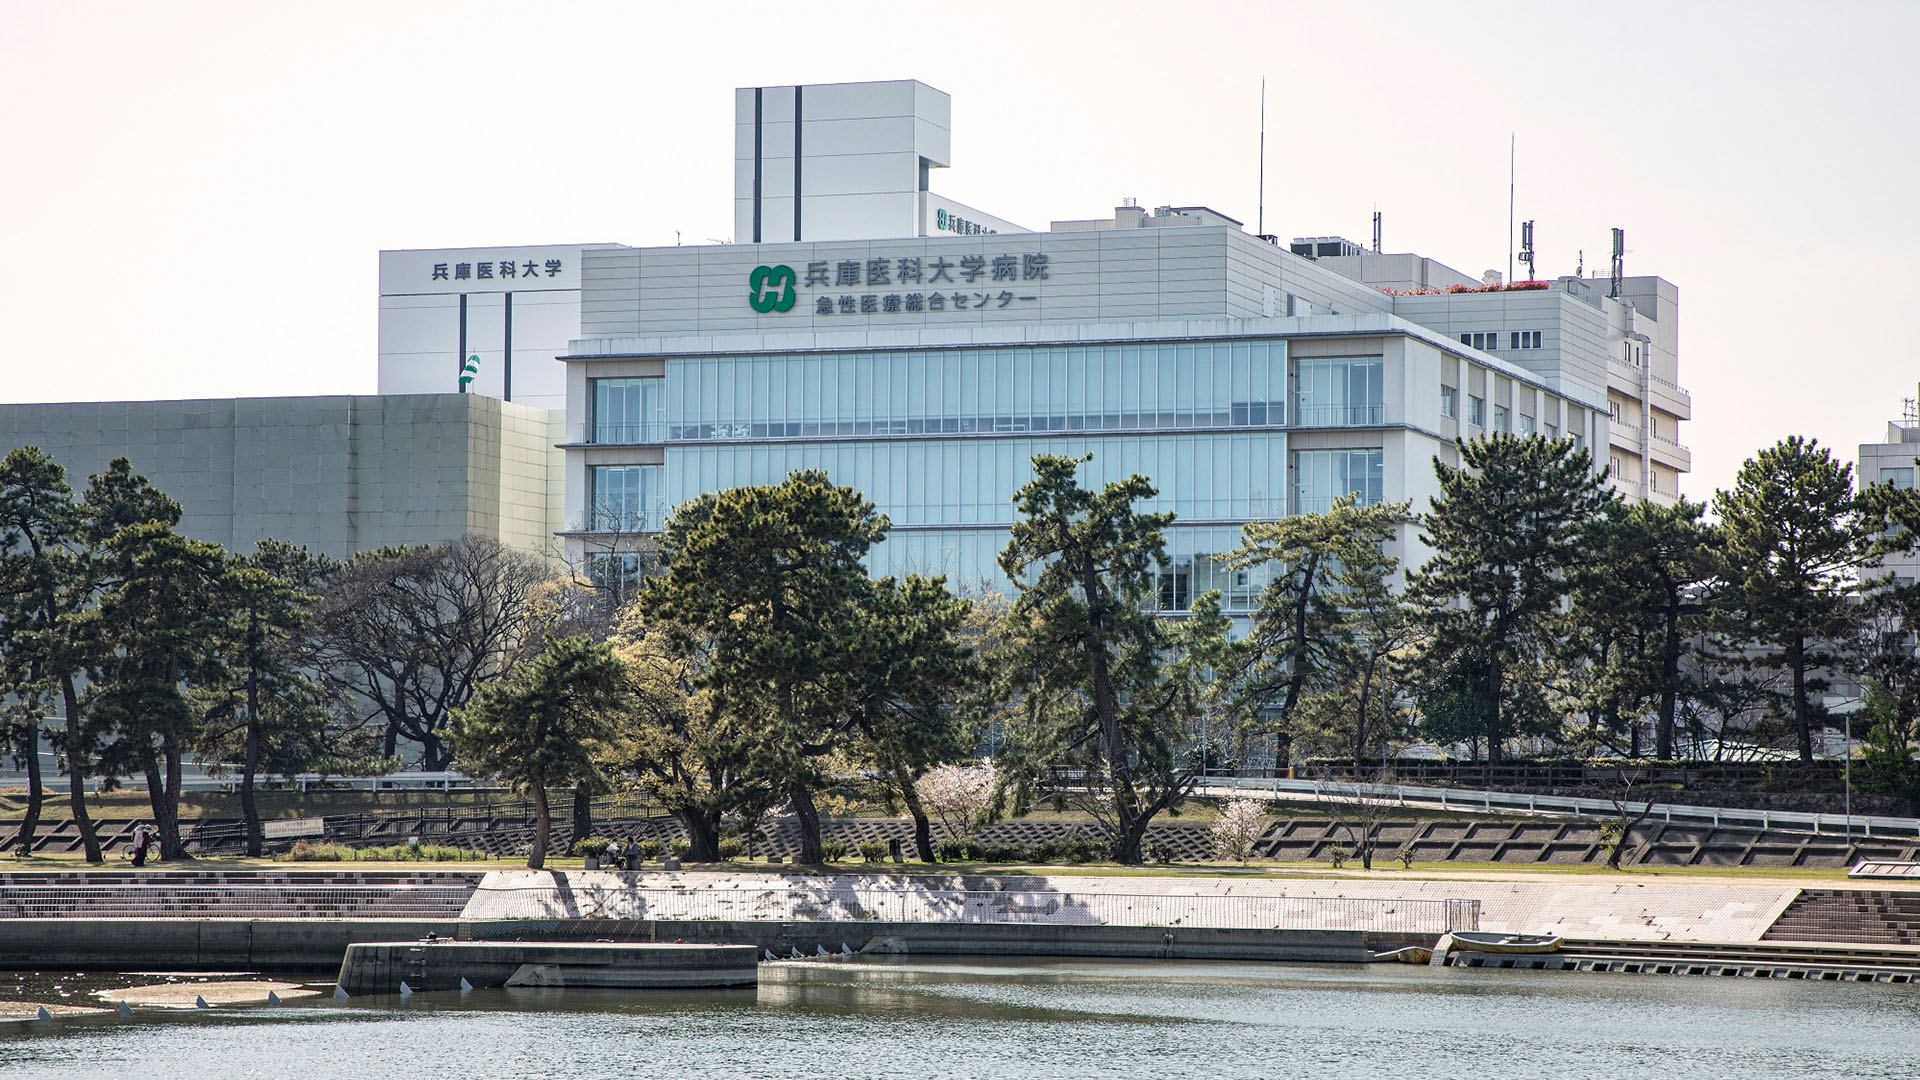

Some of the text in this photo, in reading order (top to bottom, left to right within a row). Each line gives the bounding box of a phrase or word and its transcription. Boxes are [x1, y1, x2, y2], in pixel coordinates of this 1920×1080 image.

[432, 260, 562, 281] 兵庫医科大学
[804, 253, 1049, 287] 兵庫医科大学病院
[815, 290, 1037, 315] 急性医療総合センター
